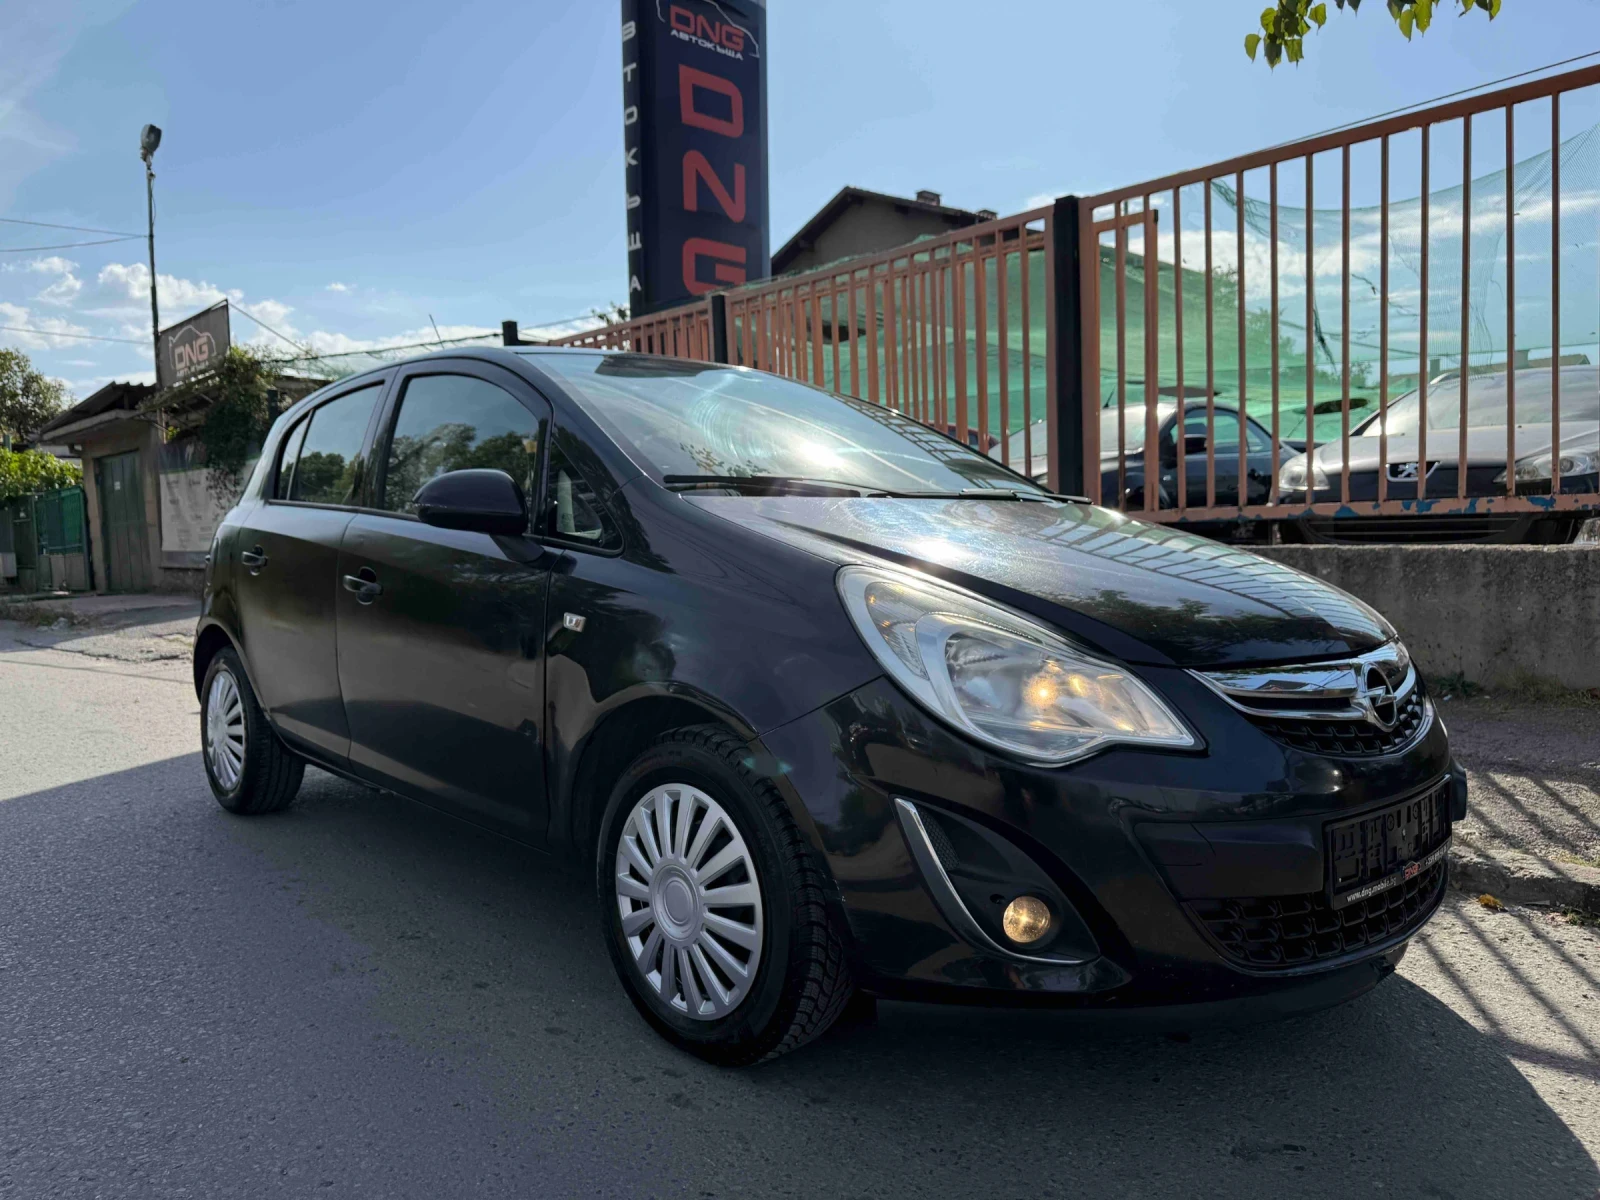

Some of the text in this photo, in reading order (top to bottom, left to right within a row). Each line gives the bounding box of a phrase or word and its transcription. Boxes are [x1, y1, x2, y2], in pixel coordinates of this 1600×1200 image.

[670, 4, 745, 52] DNG
[678, 63, 746, 297] DNG
[174, 336, 209, 371] DNG
